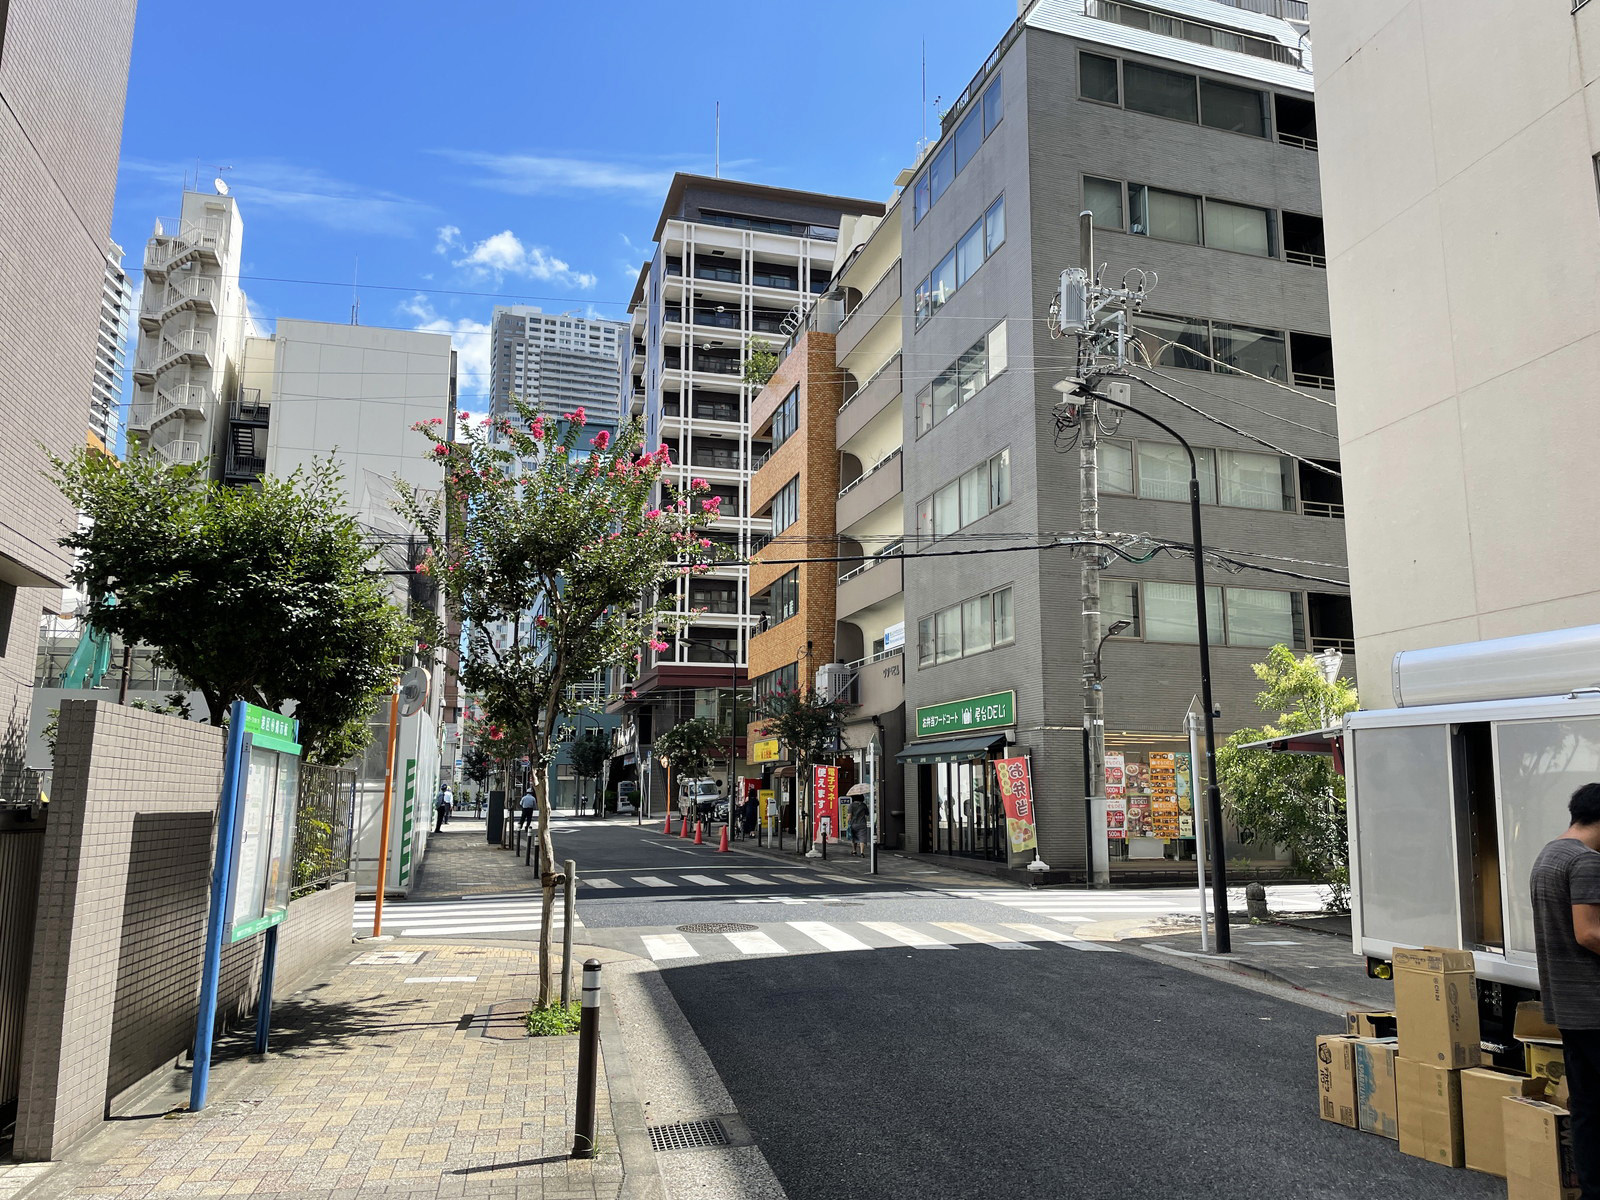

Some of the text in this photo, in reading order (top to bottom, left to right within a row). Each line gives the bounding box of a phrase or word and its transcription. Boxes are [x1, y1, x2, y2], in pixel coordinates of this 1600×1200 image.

[922, 712, 959, 728] お弁当フードコート
[817, 767, 827, 809] 使えます
[827, 767, 836, 810] 電子マネー
[1008, 762, 1028, 817] お弁当
